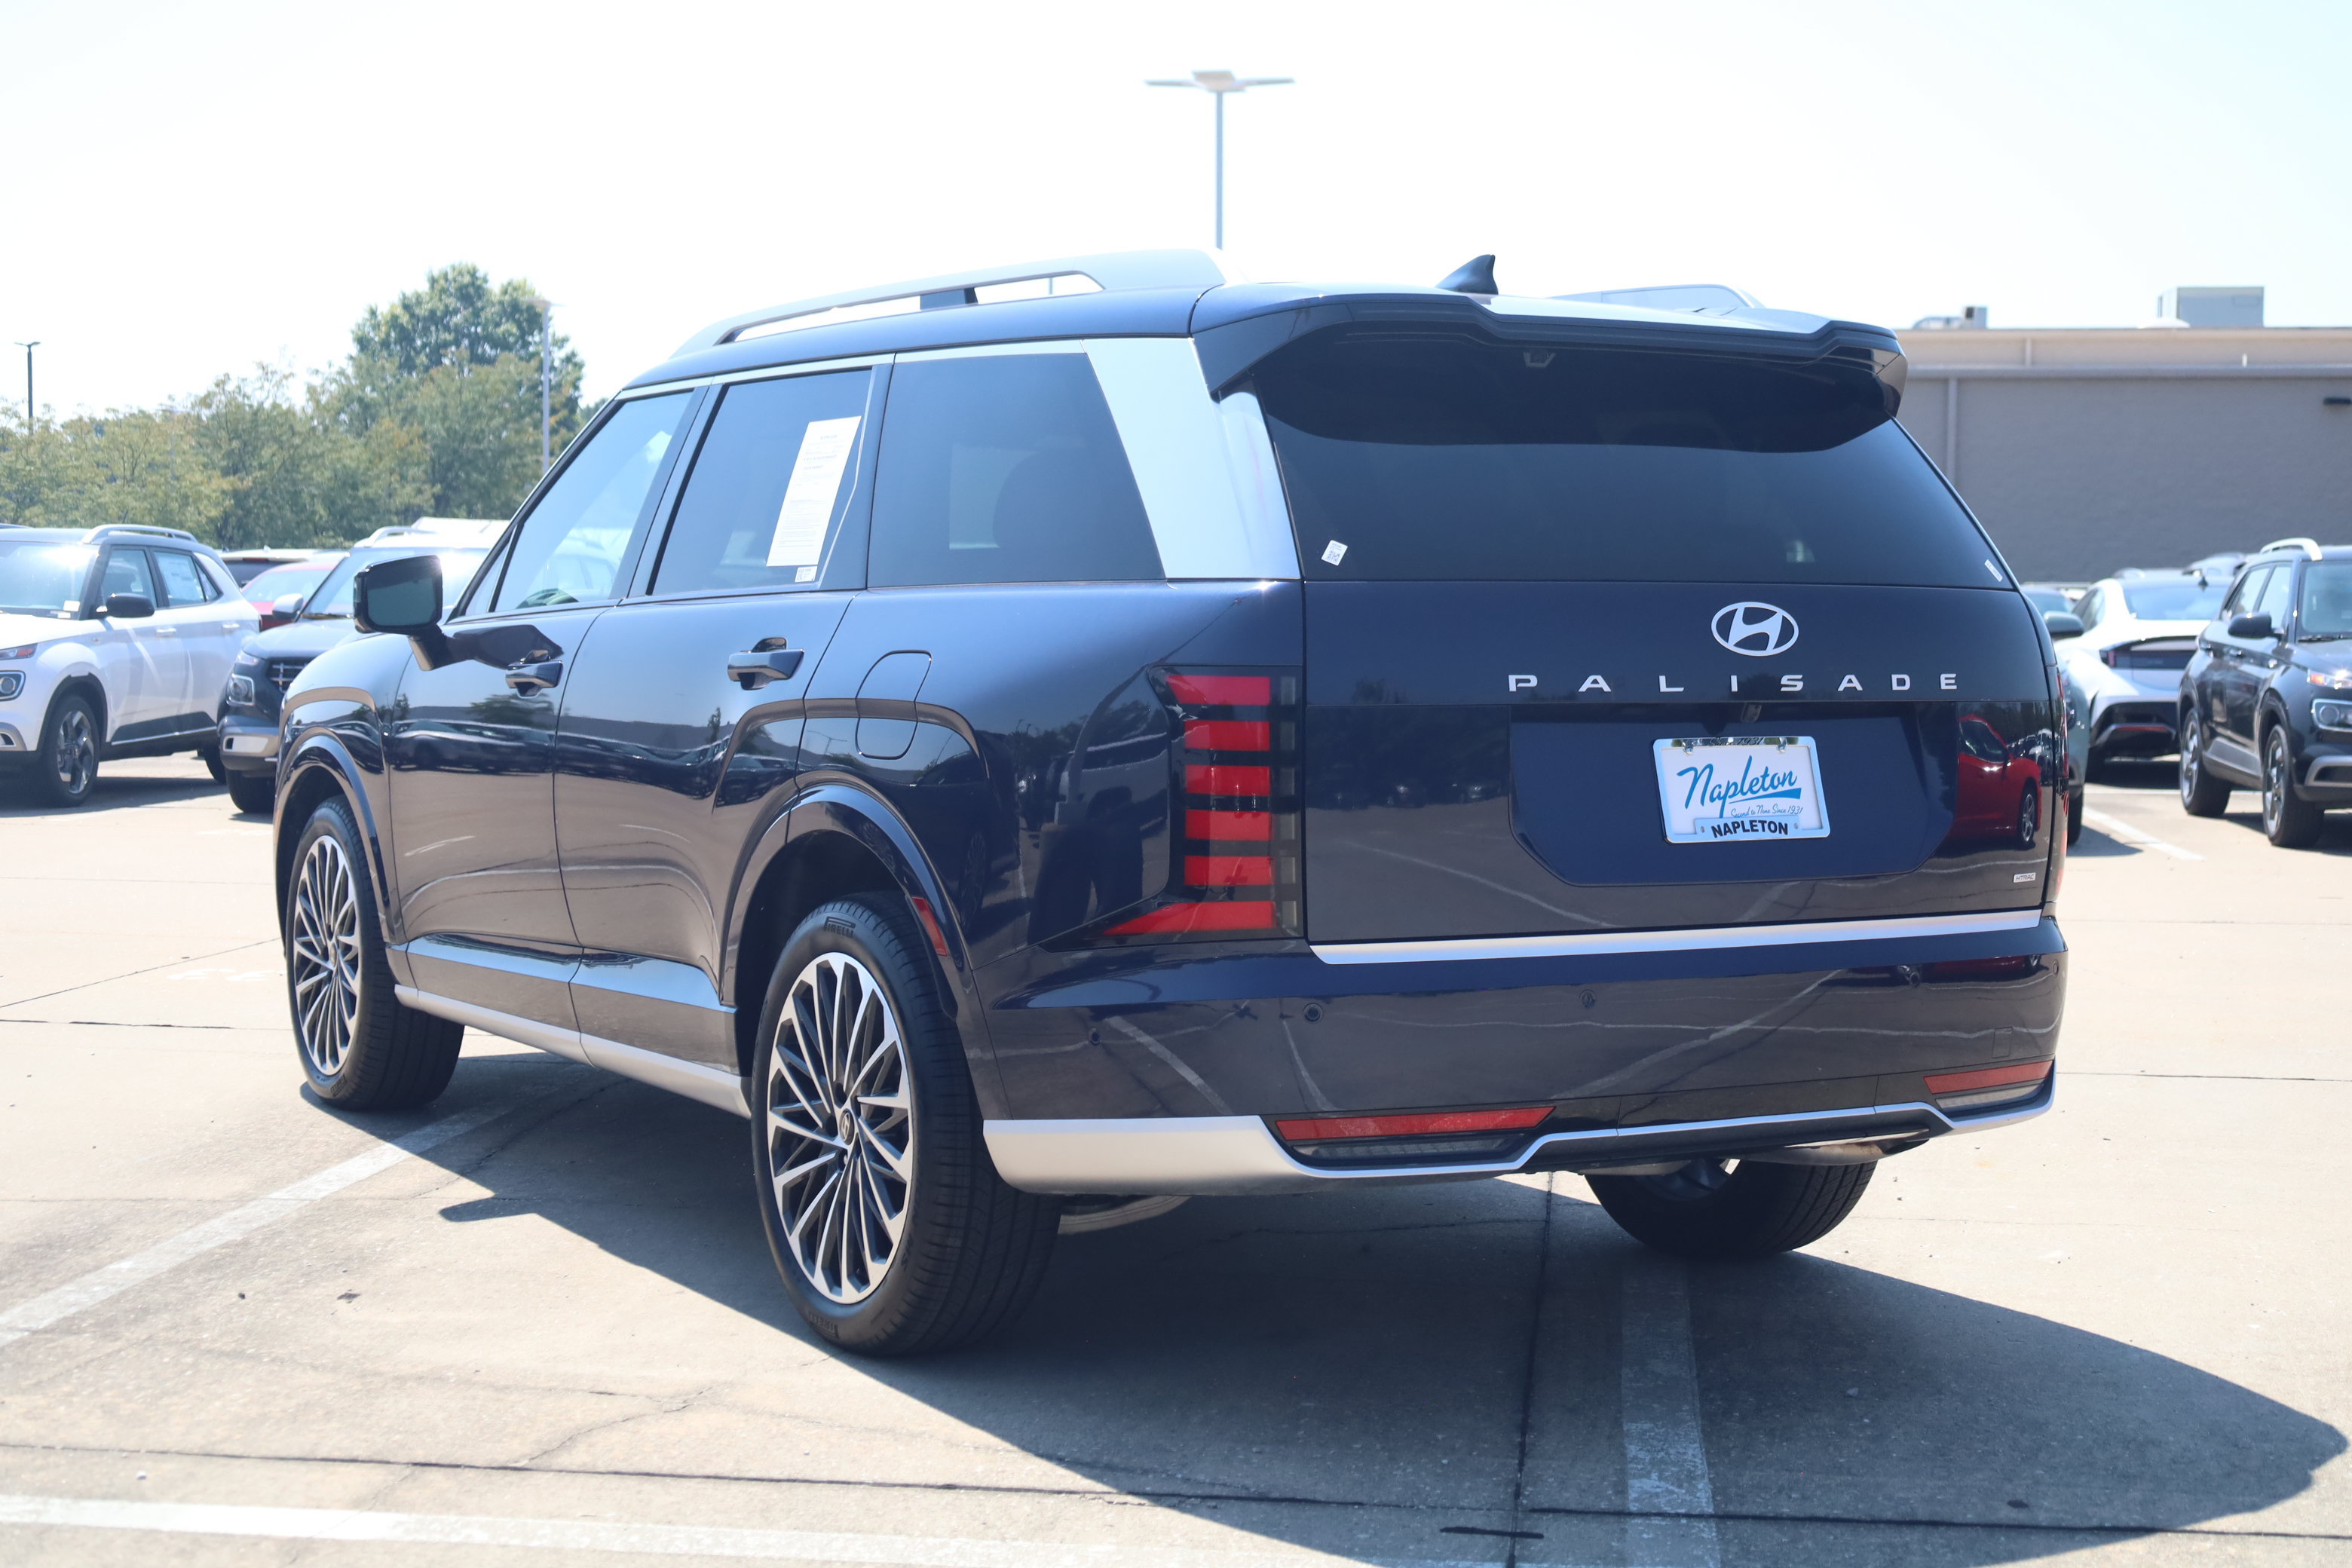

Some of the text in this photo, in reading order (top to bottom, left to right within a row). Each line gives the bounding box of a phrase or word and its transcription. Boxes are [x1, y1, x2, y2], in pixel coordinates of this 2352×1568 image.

[1508, 673, 1958, 692] PALISADE
[1737, 737, 1764, 746] 1931
[1677, 755, 1798, 818] Napleton
[1731, 806, 1750, 818] Second
[1756, 804, 1771, 815] None
[1772, 804, 1786, 814] Since
[1787, 805, 1803, 815] 1931
[1711, 820, 1788, 838] NAPLETON
[823, 916, 856, 938] PIRELLI
[807, 1309, 840, 1340] PIRELLI
